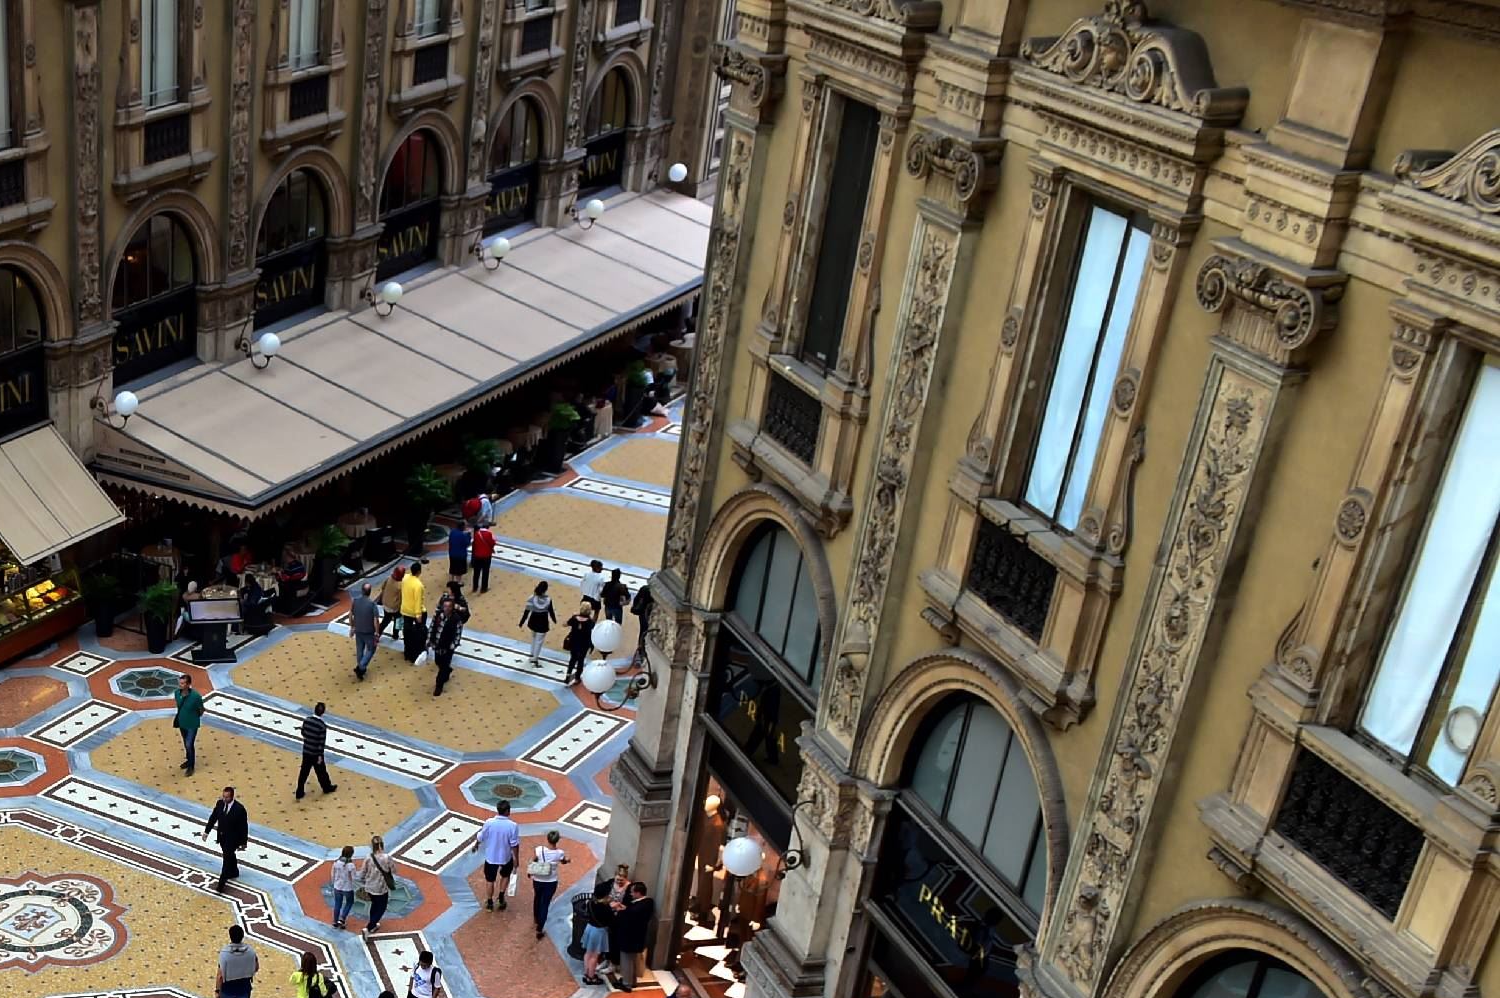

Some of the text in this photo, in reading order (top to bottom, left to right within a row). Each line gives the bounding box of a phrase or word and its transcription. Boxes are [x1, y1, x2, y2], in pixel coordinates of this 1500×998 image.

[377, 222, 430, 261] SAVINI
[256, 263, 316, 310] SAVINI
[115, 311, 184, 364] SAVINI
[918, 883, 985, 968] PRADA
